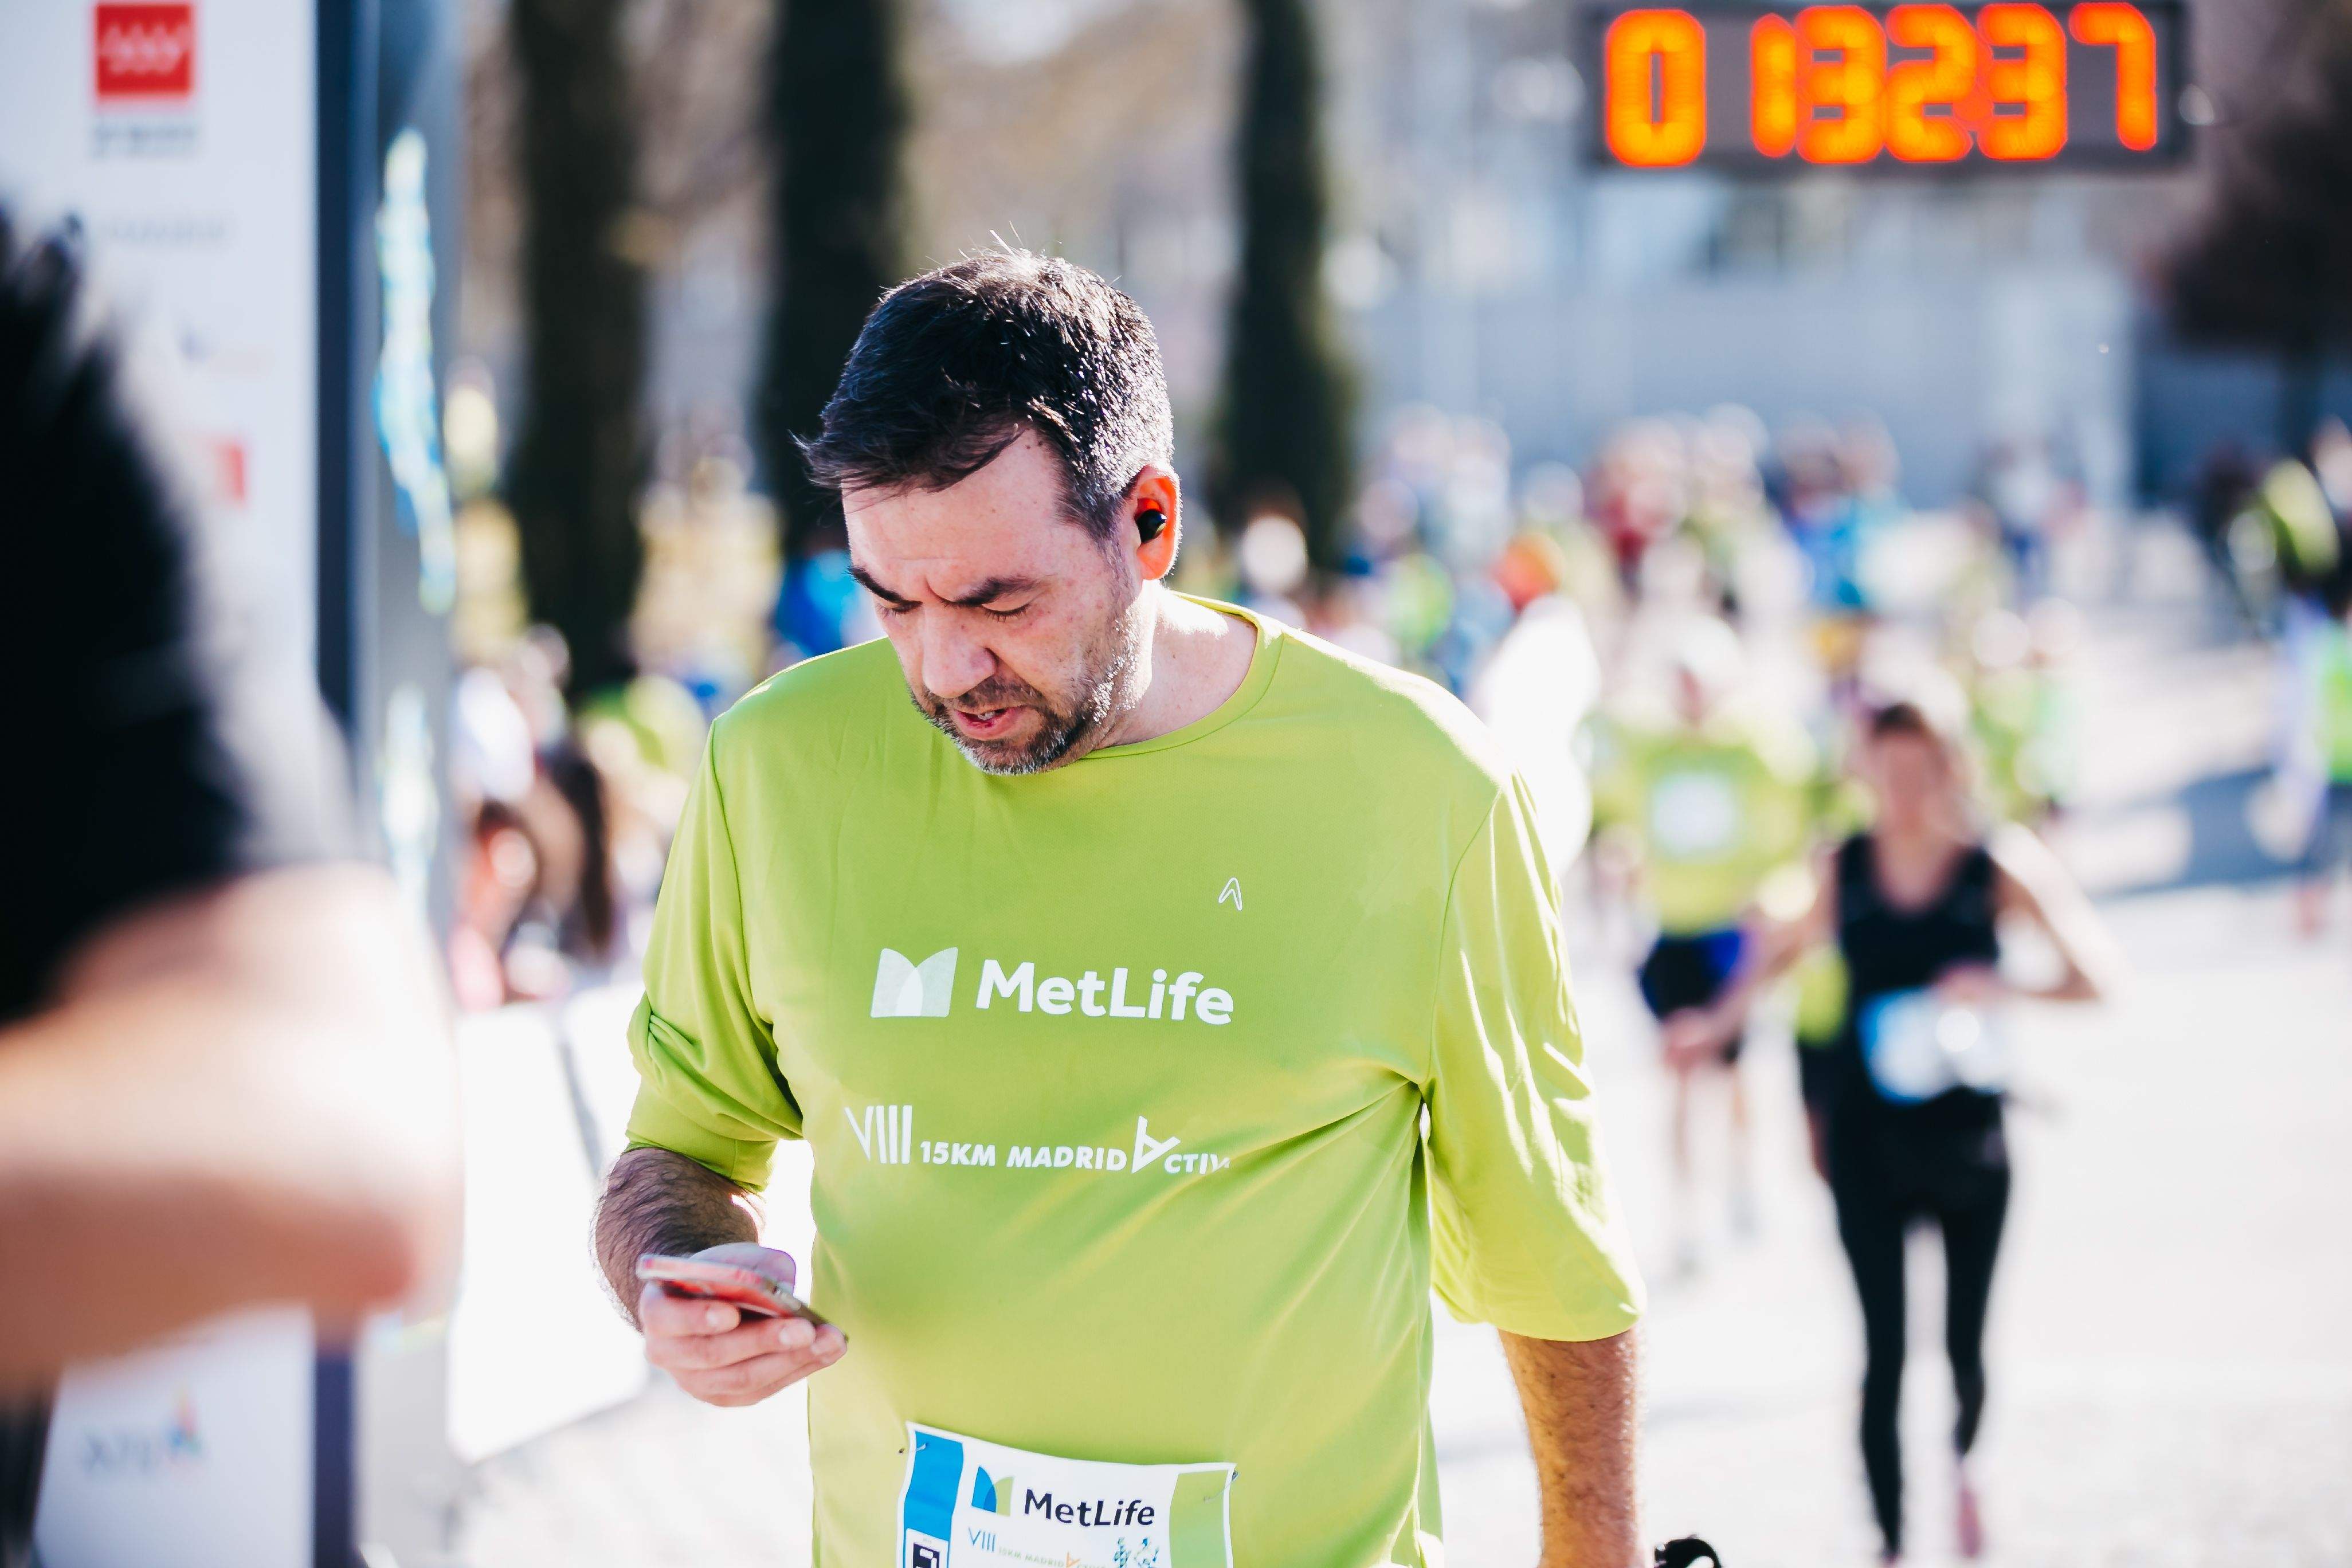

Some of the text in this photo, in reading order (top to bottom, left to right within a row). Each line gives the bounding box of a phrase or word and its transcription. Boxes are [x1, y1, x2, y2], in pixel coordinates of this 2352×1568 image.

[975, 959, 1234, 1025] MetLife
[844, 1104, 913, 1165] VIII
[920, 1140, 996, 1167] 15KM
[1006, 1146, 1128, 1171] MADRID
[1025, 1488, 1155, 1527] MetLife
[968, 1527, 996, 1552] VIII
[1025, 1553, 1064, 1567] MADRID
